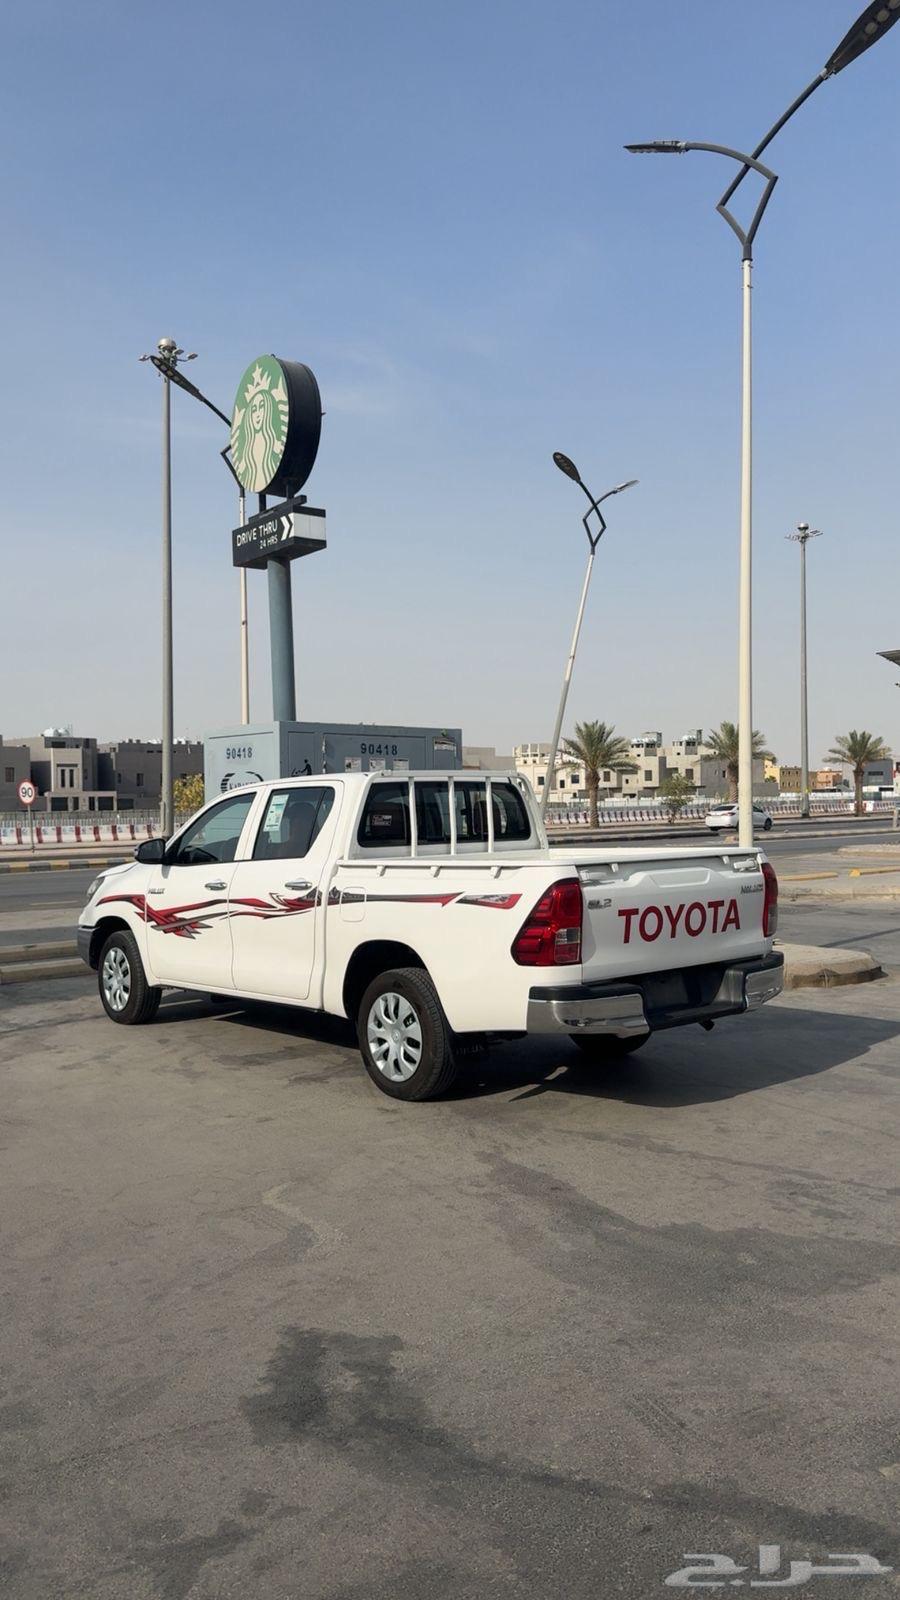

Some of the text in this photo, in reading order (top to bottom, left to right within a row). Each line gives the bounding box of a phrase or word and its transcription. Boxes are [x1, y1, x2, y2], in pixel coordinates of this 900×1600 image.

[236, 519, 278, 547] DRIVE THRU
[226, 746, 253, 759] 90418
[360, 743, 398, 756] 90418
[21, 786, 33, 798] 90
[618, 898, 741, 944] TOYOTA
